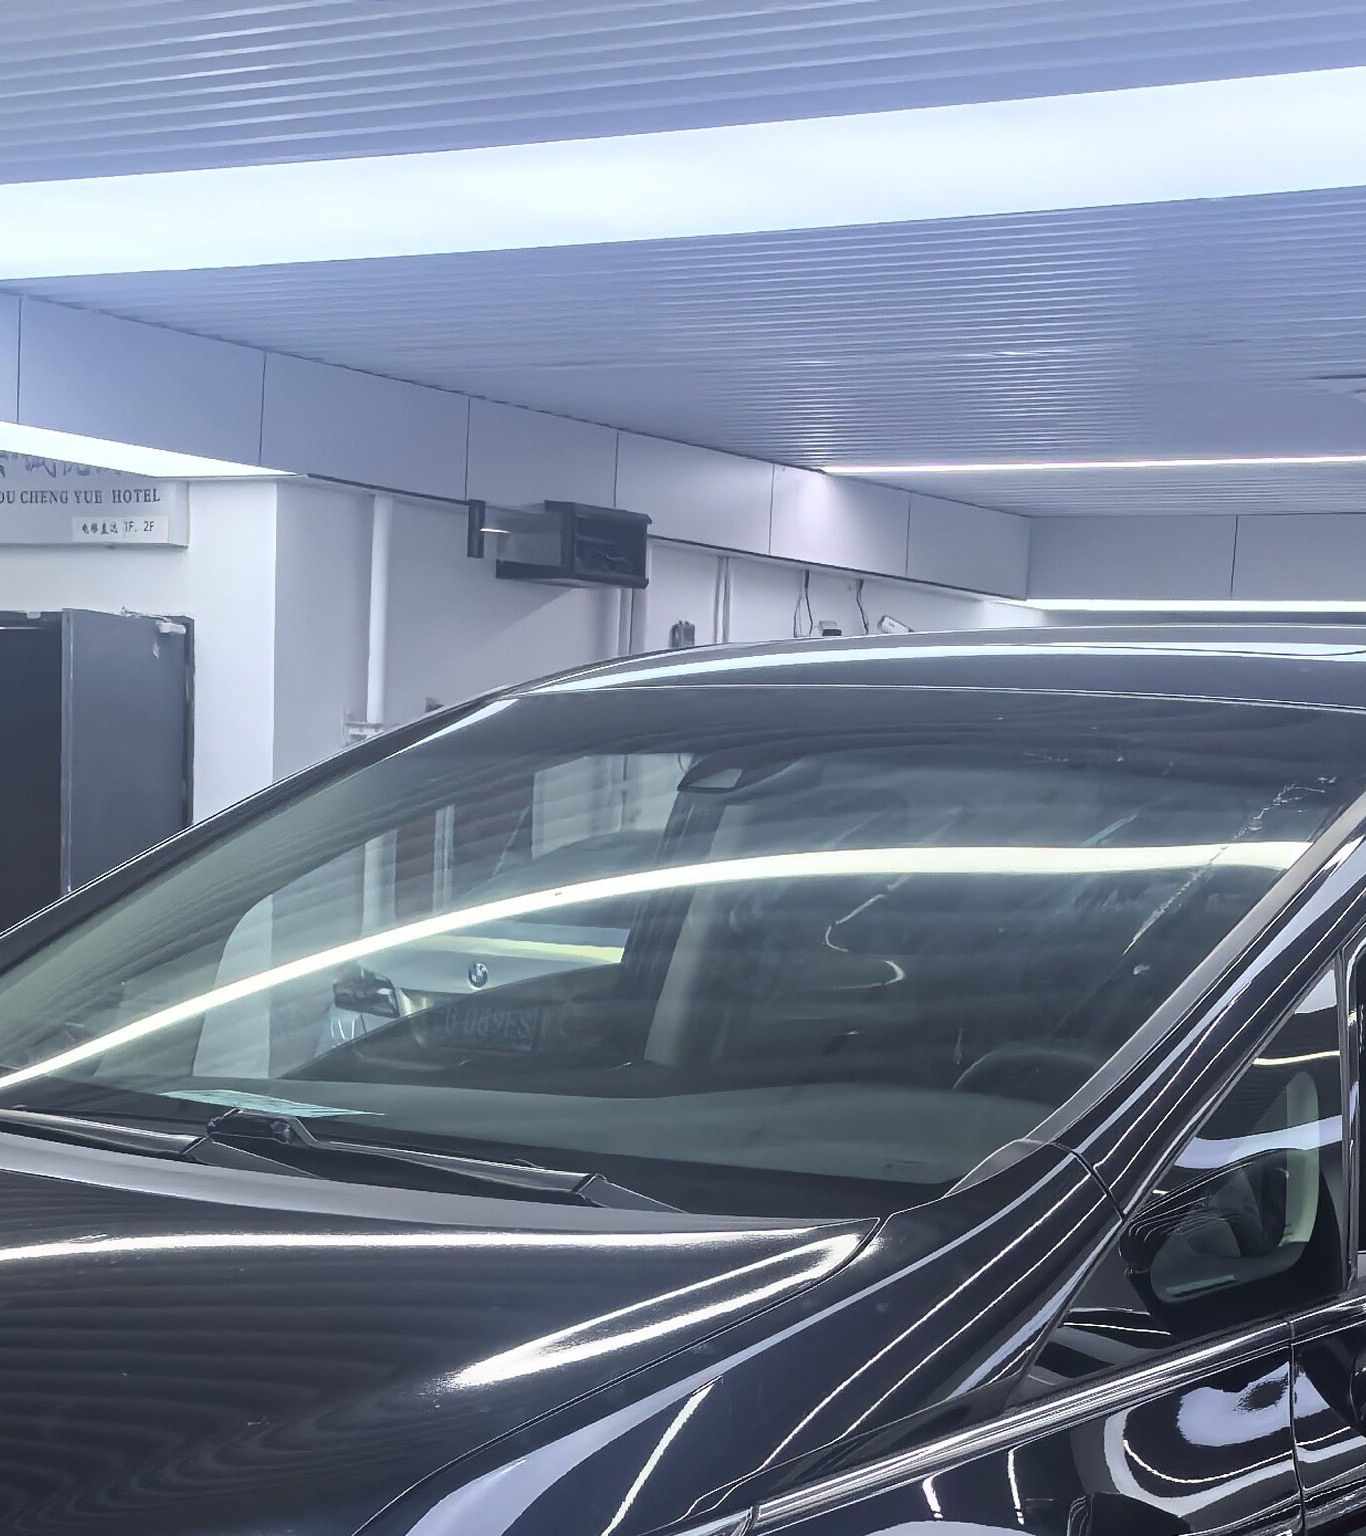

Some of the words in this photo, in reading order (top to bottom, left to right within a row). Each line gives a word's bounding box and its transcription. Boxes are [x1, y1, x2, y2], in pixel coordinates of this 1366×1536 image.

[20, 490, 68, 504] CHENG
[74, 490, 102, 504] YUE
[112, 488, 161, 504] HOTEL
